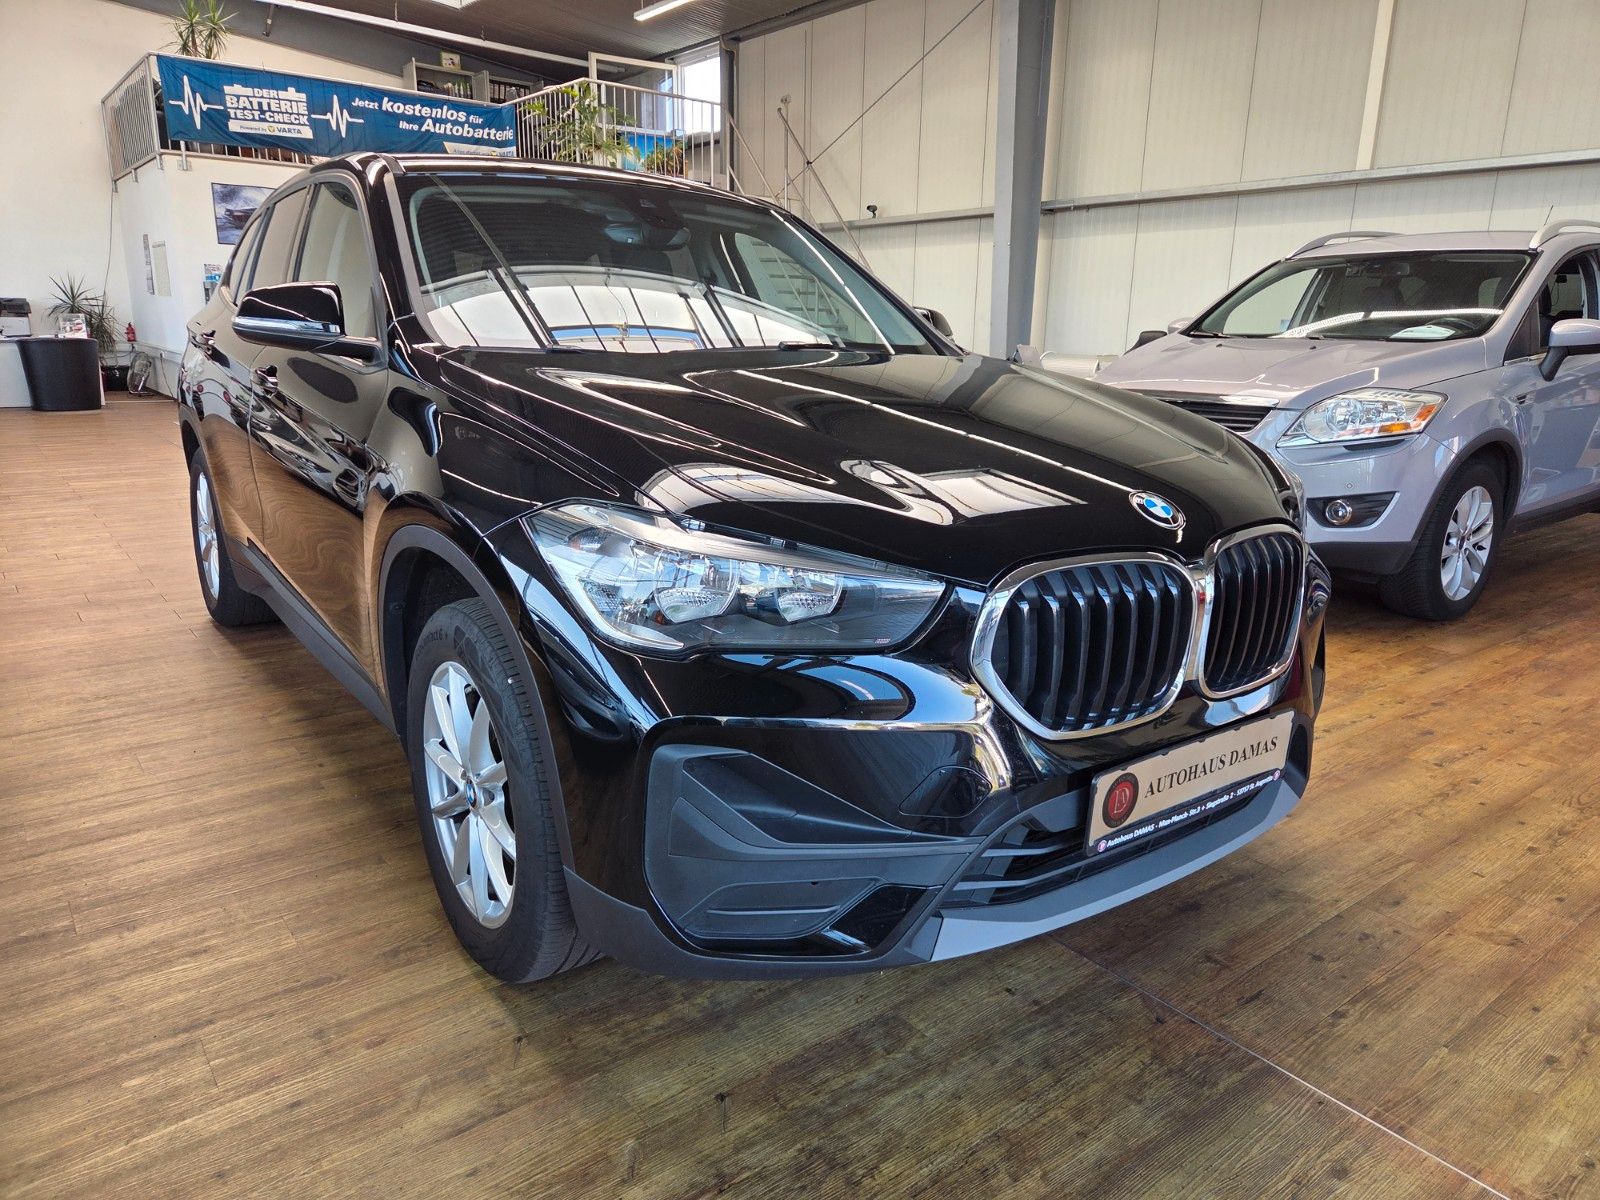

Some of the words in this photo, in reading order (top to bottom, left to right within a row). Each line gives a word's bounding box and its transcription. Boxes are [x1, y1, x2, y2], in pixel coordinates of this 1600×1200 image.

[253, 87, 279, 99] DER
[225, 94, 309, 115] BATTERIE
[351, 97, 379, 110] Jetzt
[381, 96, 467, 122] kostenlos
[469, 114, 484, 125] für
[227, 108, 310, 125] TEST-CHECK
[276, 127, 303, 135] VARTA
[399, 120, 419, 131] Ihre
[420, 118, 514, 141] Autobatterie
[1144, 753, 1227, 799] AUTOHAUS
[1228, 735, 1279, 768] DAMAS
[1107, 832, 1134, 848] Autohaus
[1133, 823, 1155, 838] DAMAS
